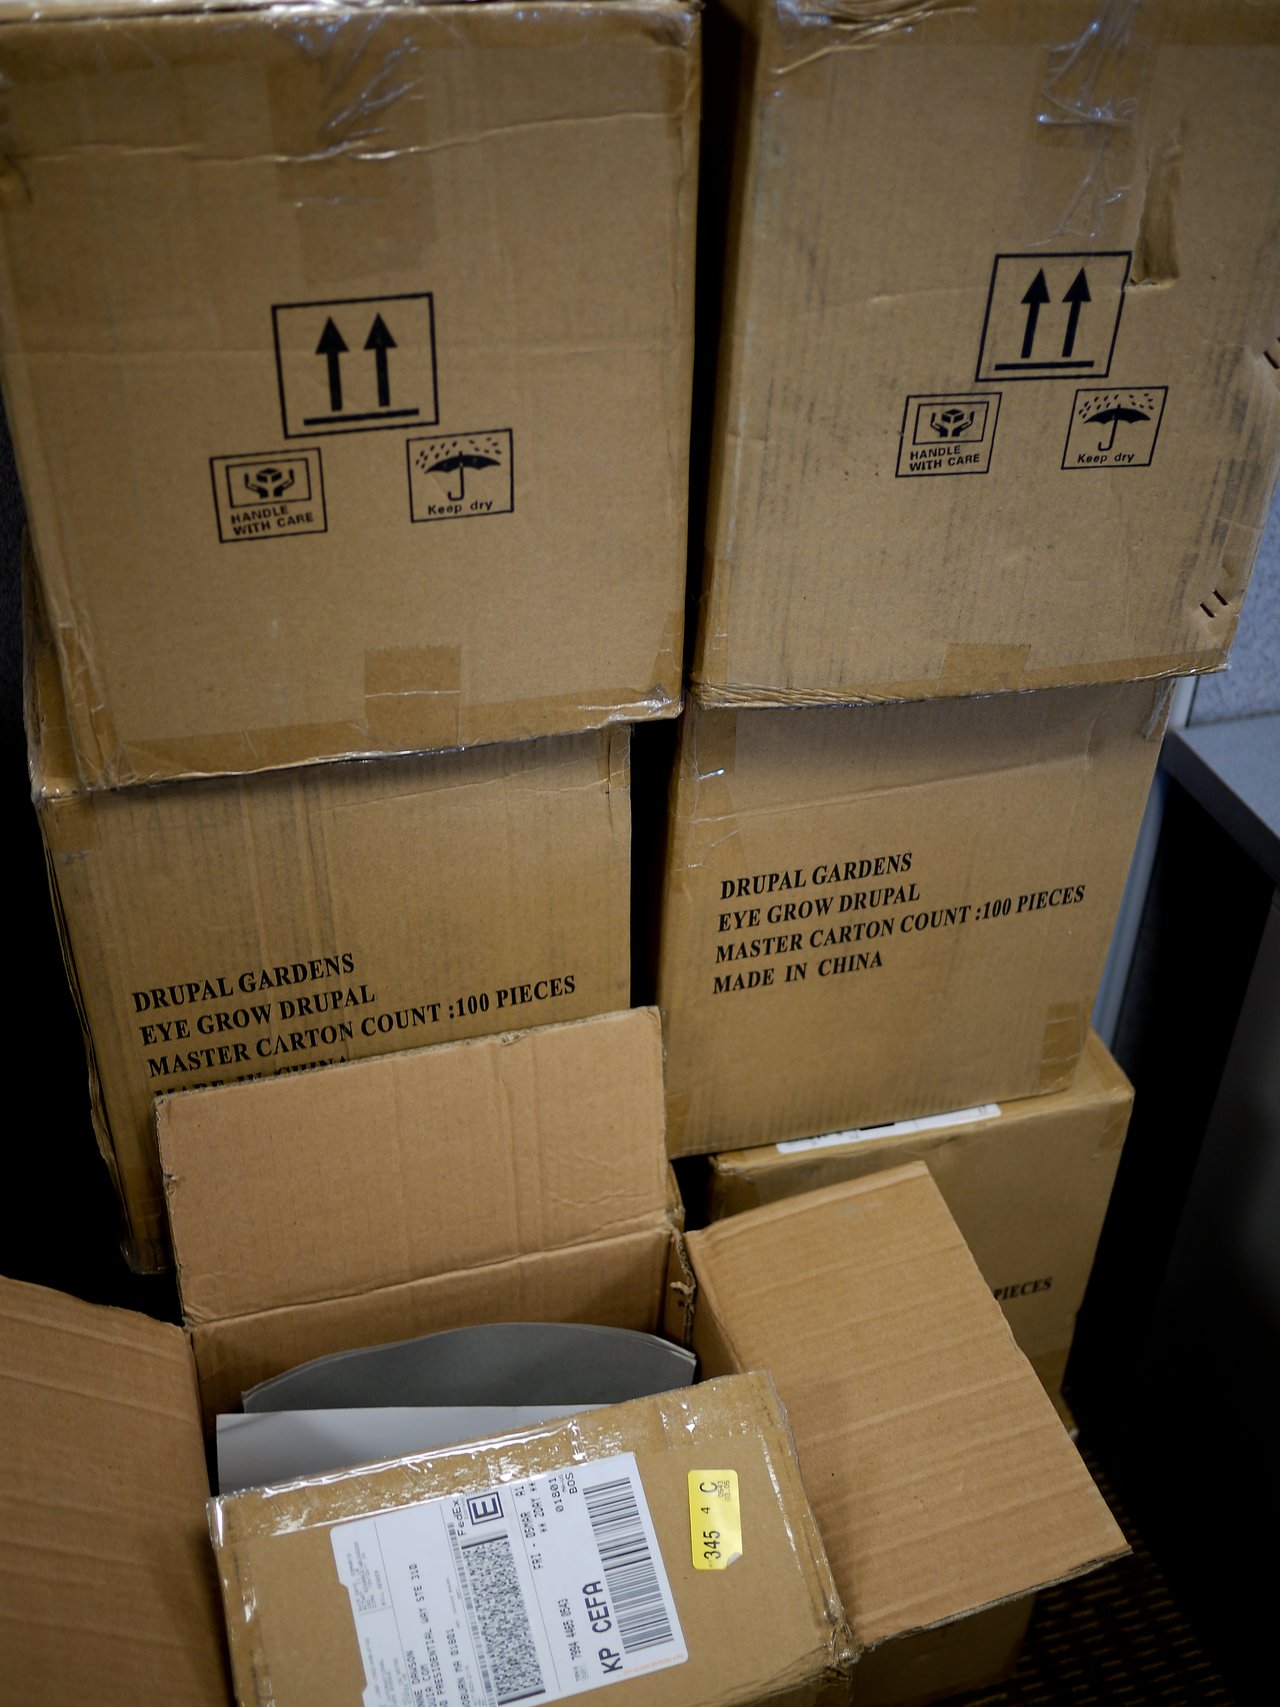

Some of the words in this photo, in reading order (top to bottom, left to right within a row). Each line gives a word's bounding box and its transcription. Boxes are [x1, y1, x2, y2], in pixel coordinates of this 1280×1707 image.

[910, 446, 961, 460] HANDLE
[910, 459, 942, 472] WITH
[948, 453, 980, 466] CARE
[1077, 453, 1108, 465] Keep
[1114, 452, 1135, 462] dry
[231, 505, 288, 525] HANDLE
[427, 502, 463, 516] Keep
[470, 500, 494, 513] dry
[233, 519, 271, 536] WITH
[276, 512, 314, 528] CARE
[720, 868, 807, 899] DRUPAL
[811, 852, 913, 886] GARDENS
[718, 908, 760, 932] EYE
[766, 896, 834, 924] GROW
[838, 883, 921, 912] DRUPAL
[715, 934, 803, 963] MASTER
[809, 918, 895, 948] CARTON
[900, 904, 972, 933] COUNT
[974, 899, 1012, 922] :100
[1016, 884, 1086, 914] PIECES
[133, 977, 234, 1013] DRUPAL
[238, 952, 355, 994] GARDENS
[712, 968, 775, 995] MADE
[785, 962, 807, 983] IN
[818, 950, 883, 977] CHINA
[139, 1016, 191, 1046] EYE
[196, 1003, 273, 1035] GROW
[280, 984, 376, 1020] DRUPAL
[147, 1042, 251, 1078] MASTER
[256, 1020, 354, 1058] CARTON
[360, 1002, 441, 1036] COUNT
[447, 993, 490, 1021] :100
[495, 974, 577, 1010] PIECES
[993, 1276, 1053, 1300] PIECES
[514, 1485, 525, 1497] A1
[565, 1472, 578, 1494] BOS
[700, 1482, 718, 1493] C
[549, 1477, 564, 1513] 01801
[452, 1499, 466, 1536] FedEx
[471, 1497, 499, 1519] E
[530, 1497, 545, 1518] 2DAY
[700, 1506, 710, 1514] 4
[520, 1511, 536, 1538] 05MAR
[703, 1530, 722, 1560] 345
[408, 1563, 420, 1580] 310
[530, 1553, 543, 1570] FRI
[413, 1584, 425, 1602] STE
[418, 1607, 430, 1624] WAY
[557, 1598, 571, 1617] 0543
[582, 1580, 612, 1633] CEFA
[563, 1619, 576, 1638] 4465
[446, 1628, 459, 1656] 01801
[568, 1641, 582, 1661] 7994
[405, 1650, 421, 1685] DAWSON
[424, 1627, 444, 1695] PRESIDENTIAL
[453, 1660, 463, 1673] MA
[598, 1647, 623, 1674] KP
